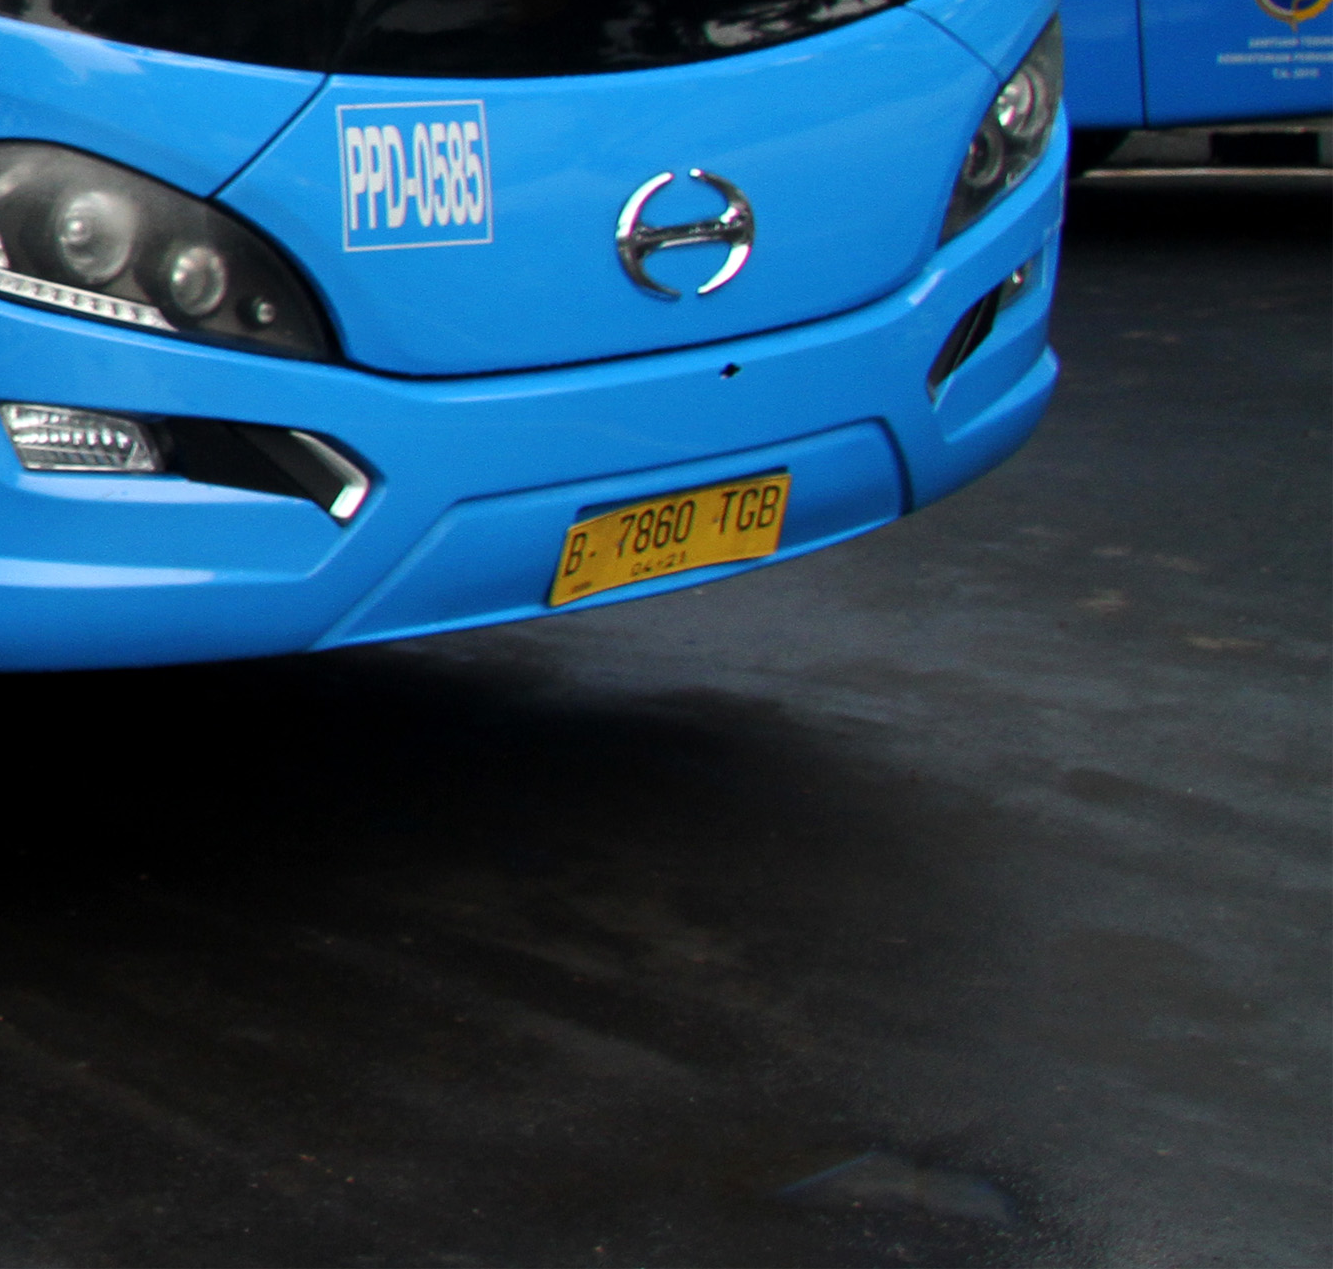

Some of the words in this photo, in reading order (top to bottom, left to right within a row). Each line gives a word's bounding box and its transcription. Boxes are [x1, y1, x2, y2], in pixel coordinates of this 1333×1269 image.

[346, 122, 486, 230] PPD-0585
[564, 532, 587, 578] B
[616, 499, 696, 559] 7860
[717, 484, 782, 536] TGB
